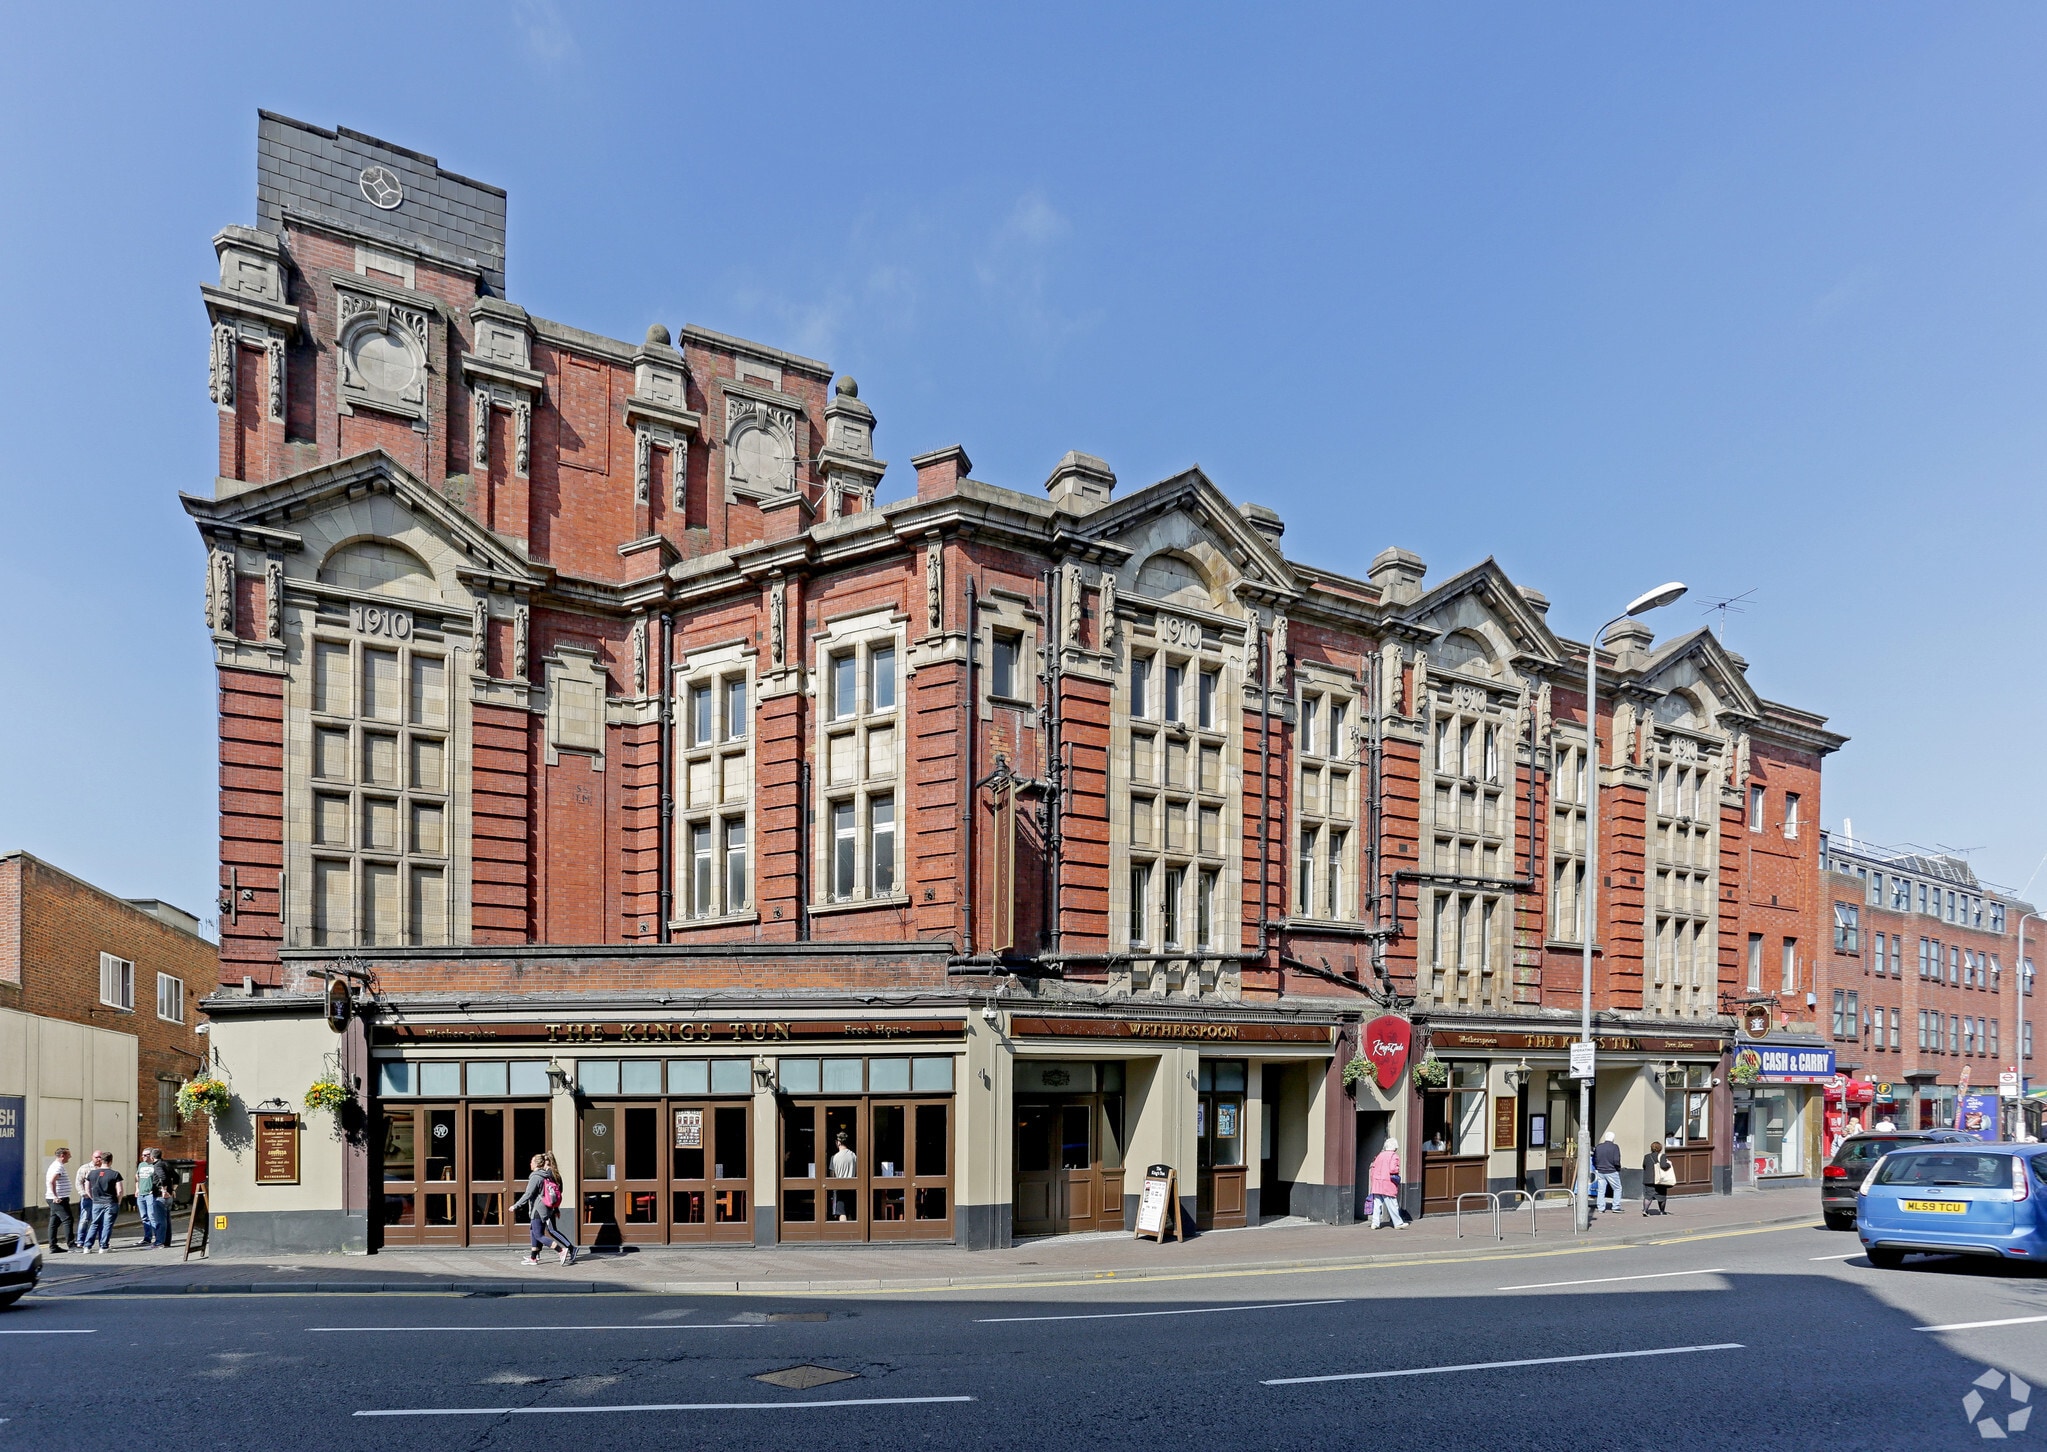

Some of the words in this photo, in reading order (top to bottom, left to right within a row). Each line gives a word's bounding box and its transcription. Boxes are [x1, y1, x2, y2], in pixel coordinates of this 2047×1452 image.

[355, 606, 409, 637] 1910
[1161, 616, 1200, 647] 1910
[1457, 687, 1486, 711] 1910
[1675, 738, 1697, 760] 1910
[424, 1028, 496, 1040] Wetherpoon
[545, 1023, 602, 1042] THE
[620, 1023, 712, 1042] KINGS
[729, 1022, 791, 1041] TUN
[875, 1024, 912, 1035] Houe
[1128, 1022, 1239, 1038] WETHERSPOON
[1523, 1034, 1556, 1048] THE
[1562, 1036, 1606, 1049] KIS
[1611, 1037, 1640, 1050] TUN
[1762, 1051, 1788, 1072] CASH
[1790, 1055, 1798, 1072] &
[1798, 1053, 1829, 1072] CARRY
[0, 1127, 15, 1138] AIR
[1907, 1201, 1936, 1211] ML59
[1939, 1203, 1961, 1212] TCU
